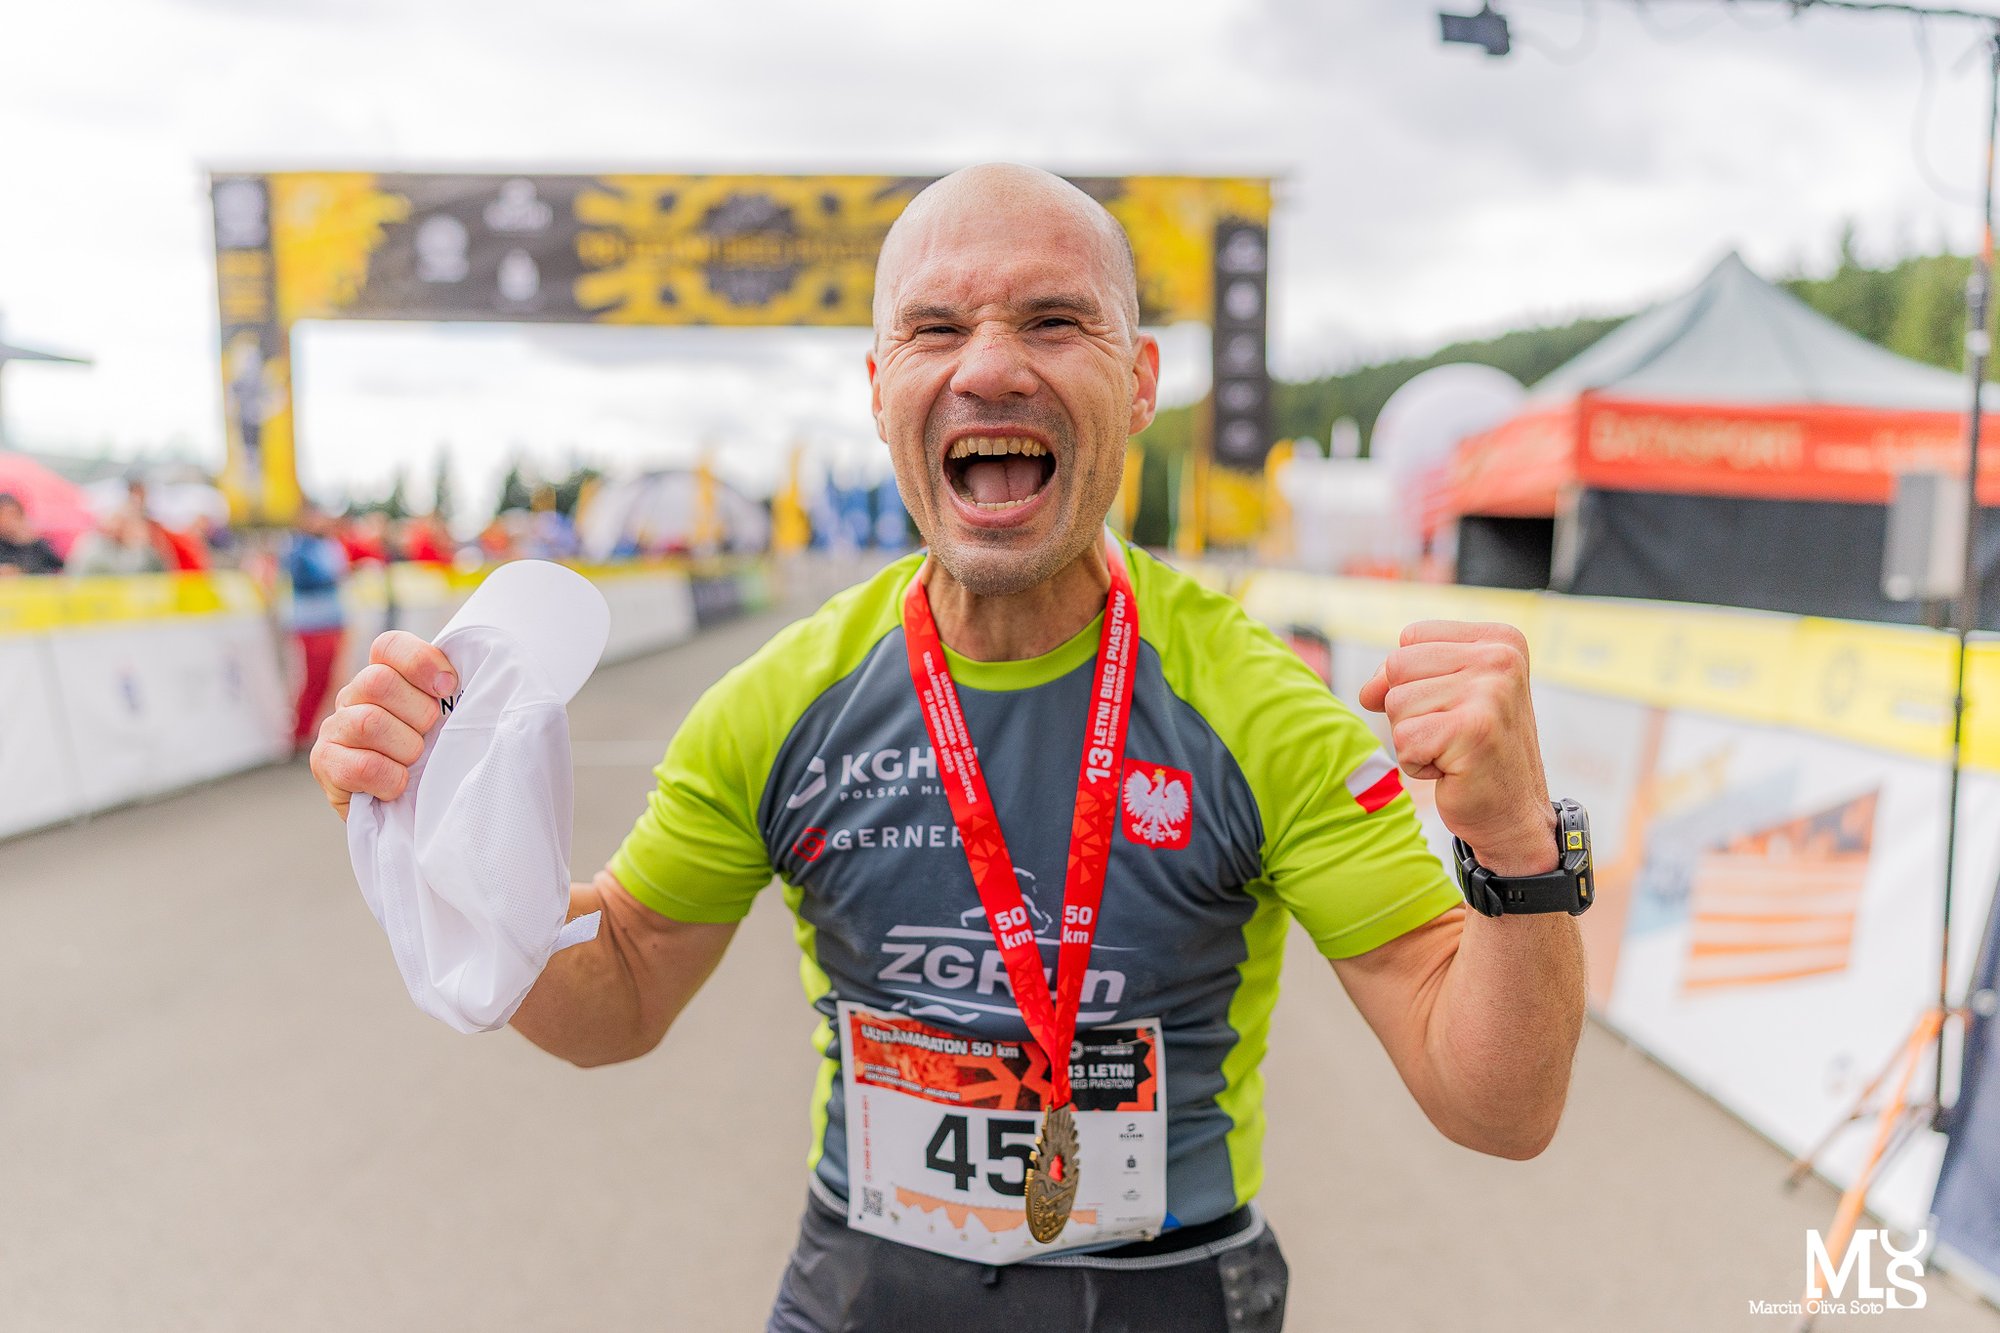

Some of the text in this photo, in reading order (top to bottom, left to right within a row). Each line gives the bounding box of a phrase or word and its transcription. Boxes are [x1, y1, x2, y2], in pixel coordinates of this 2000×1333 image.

[1086, 590, 1126, 784] 13 LETNI BIEG PIASTÓW
[939, 671, 969, 748] ULTRAMARATON
[840, 746, 978, 786] KGH
[839, 785, 910, 802] POLSKA
[994, 906, 1028, 931] 50
[1065, 905, 1093, 925] 50
[1000, 927, 1034, 950] km
[1063, 925, 1089, 944] km
[861, 1024, 1019, 1059] ULTRAMARATON 50 km
[1088, 1063, 1135, 1078] LETNI
[1070, 1079, 1088, 1090] IEG
[926, 1109, 1040, 1196] 45
